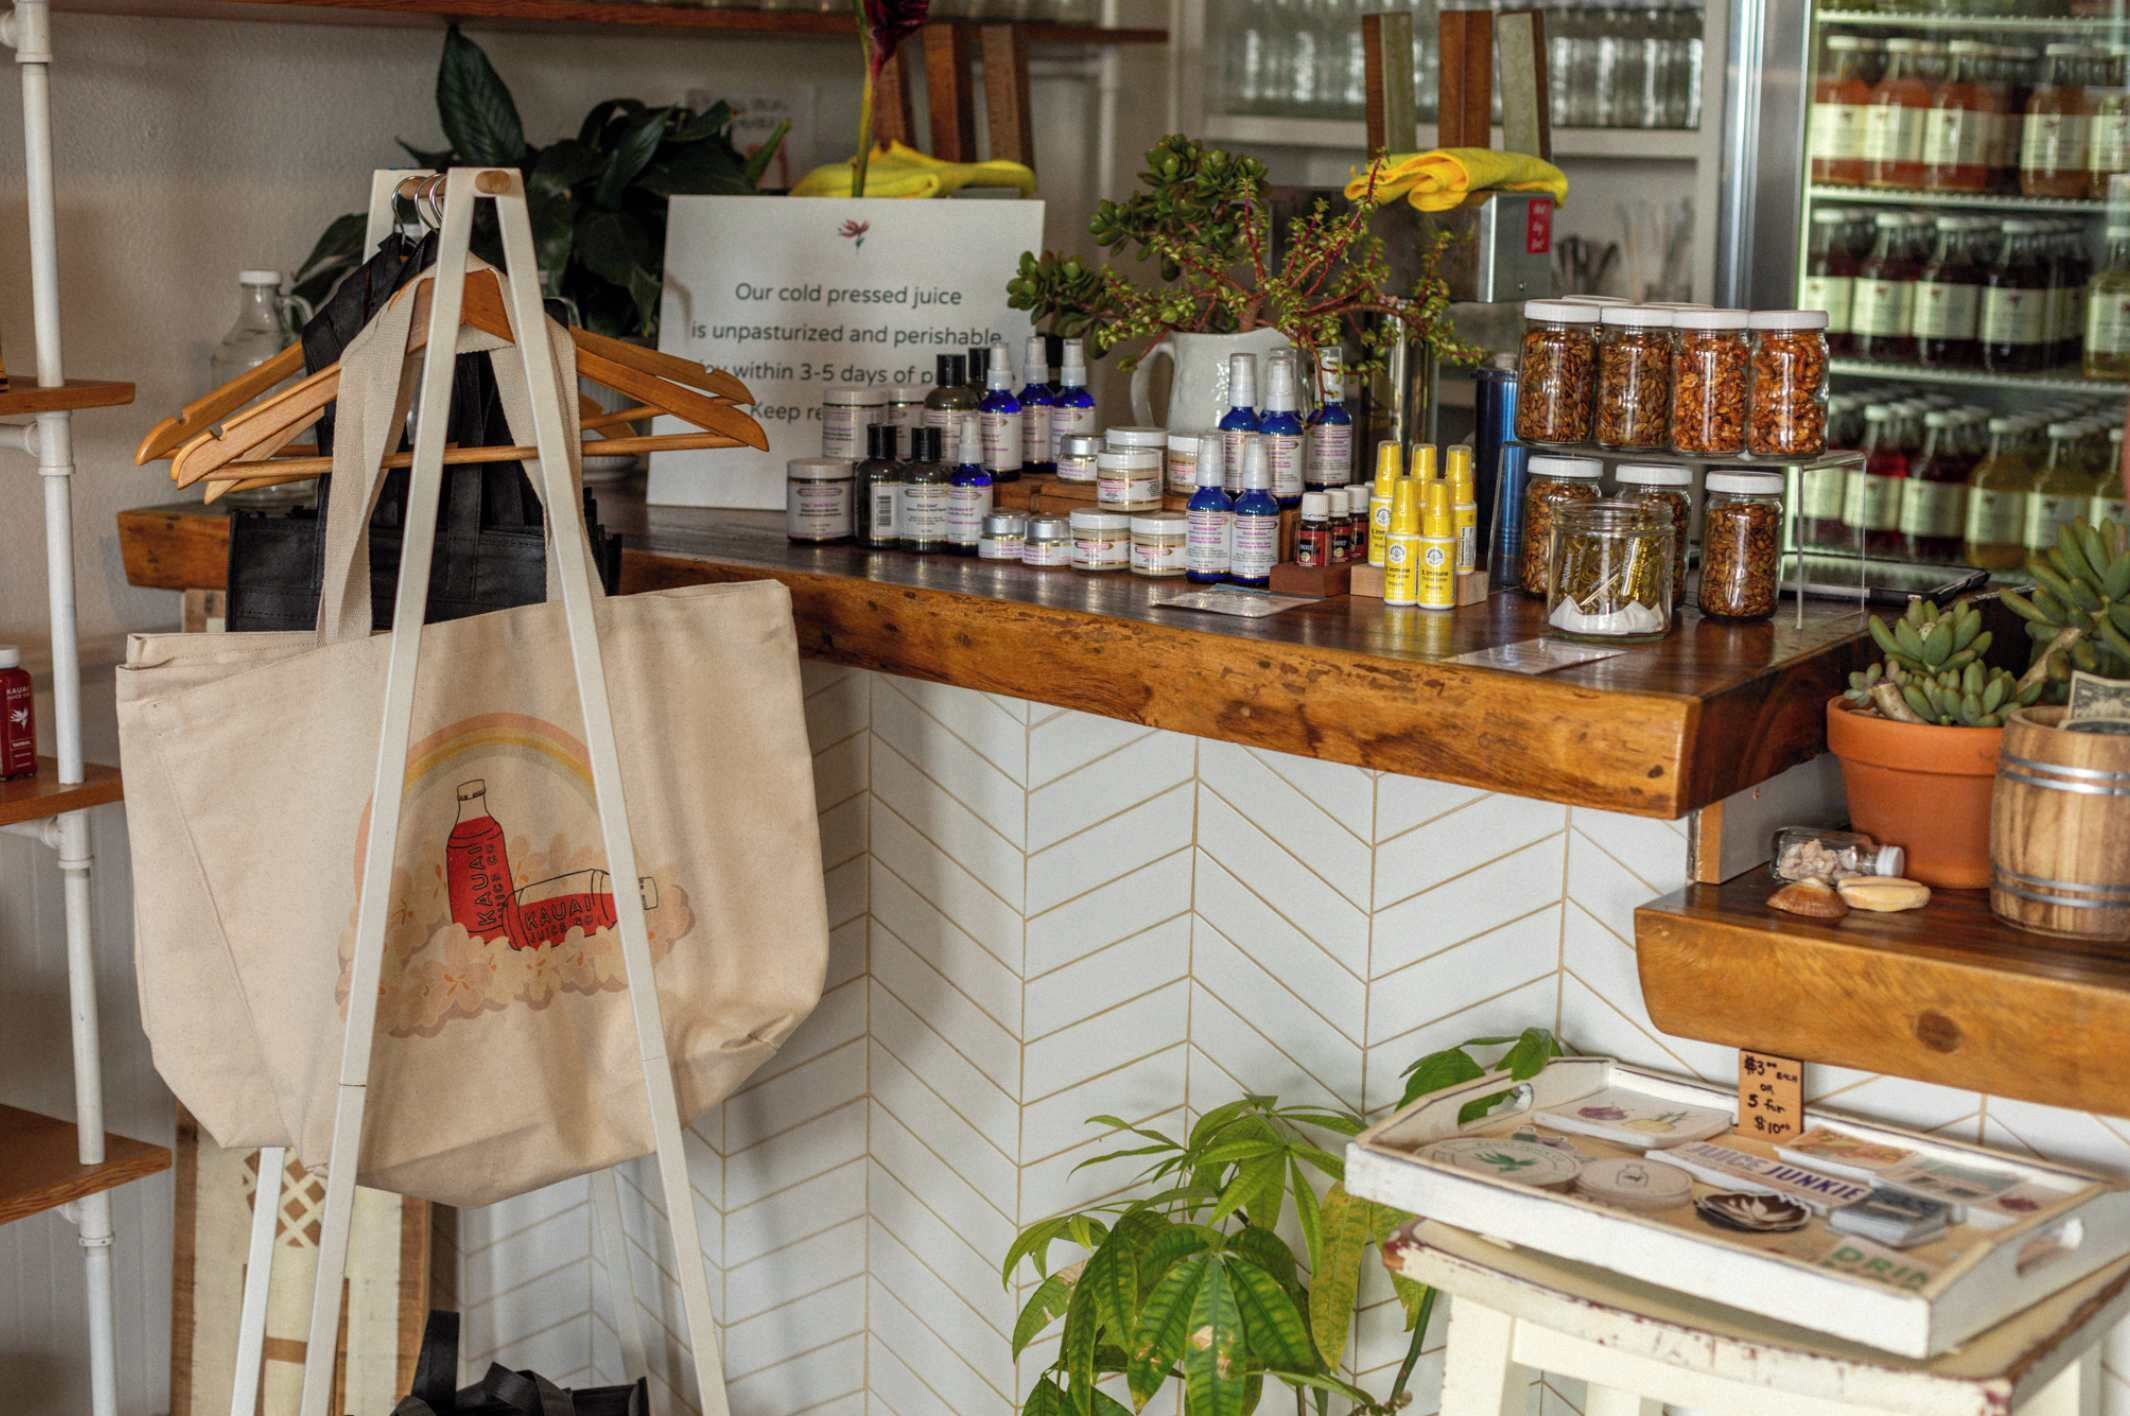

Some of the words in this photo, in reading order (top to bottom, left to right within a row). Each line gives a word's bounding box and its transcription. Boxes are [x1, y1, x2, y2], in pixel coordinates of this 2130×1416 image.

[735, 283, 772, 300] Our
[778, 284, 821, 301] cold
[827, 286, 907, 307] pressed
[912, 286, 962, 309] juice
[691, 322, 706, 338] is
[712, 324, 843, 343] unpasturized
[850, 326, 887, 343] and
[893, 327, 1001, 347] perishable
[733, 362, 793, 380] within
[800, 363, 834, 382] 3-5
[840, 364, 887, 385] days
[893, 365, 915, 384] of
[749, 402, 800, 422] Keep
[467, 844, 497, 926] KAUAI
[525, 895, 592, 930] KAUAI
[1748, 1093, 1759, 1109] 5
[1760, 1165, 1867, 1200] JUNKIE
